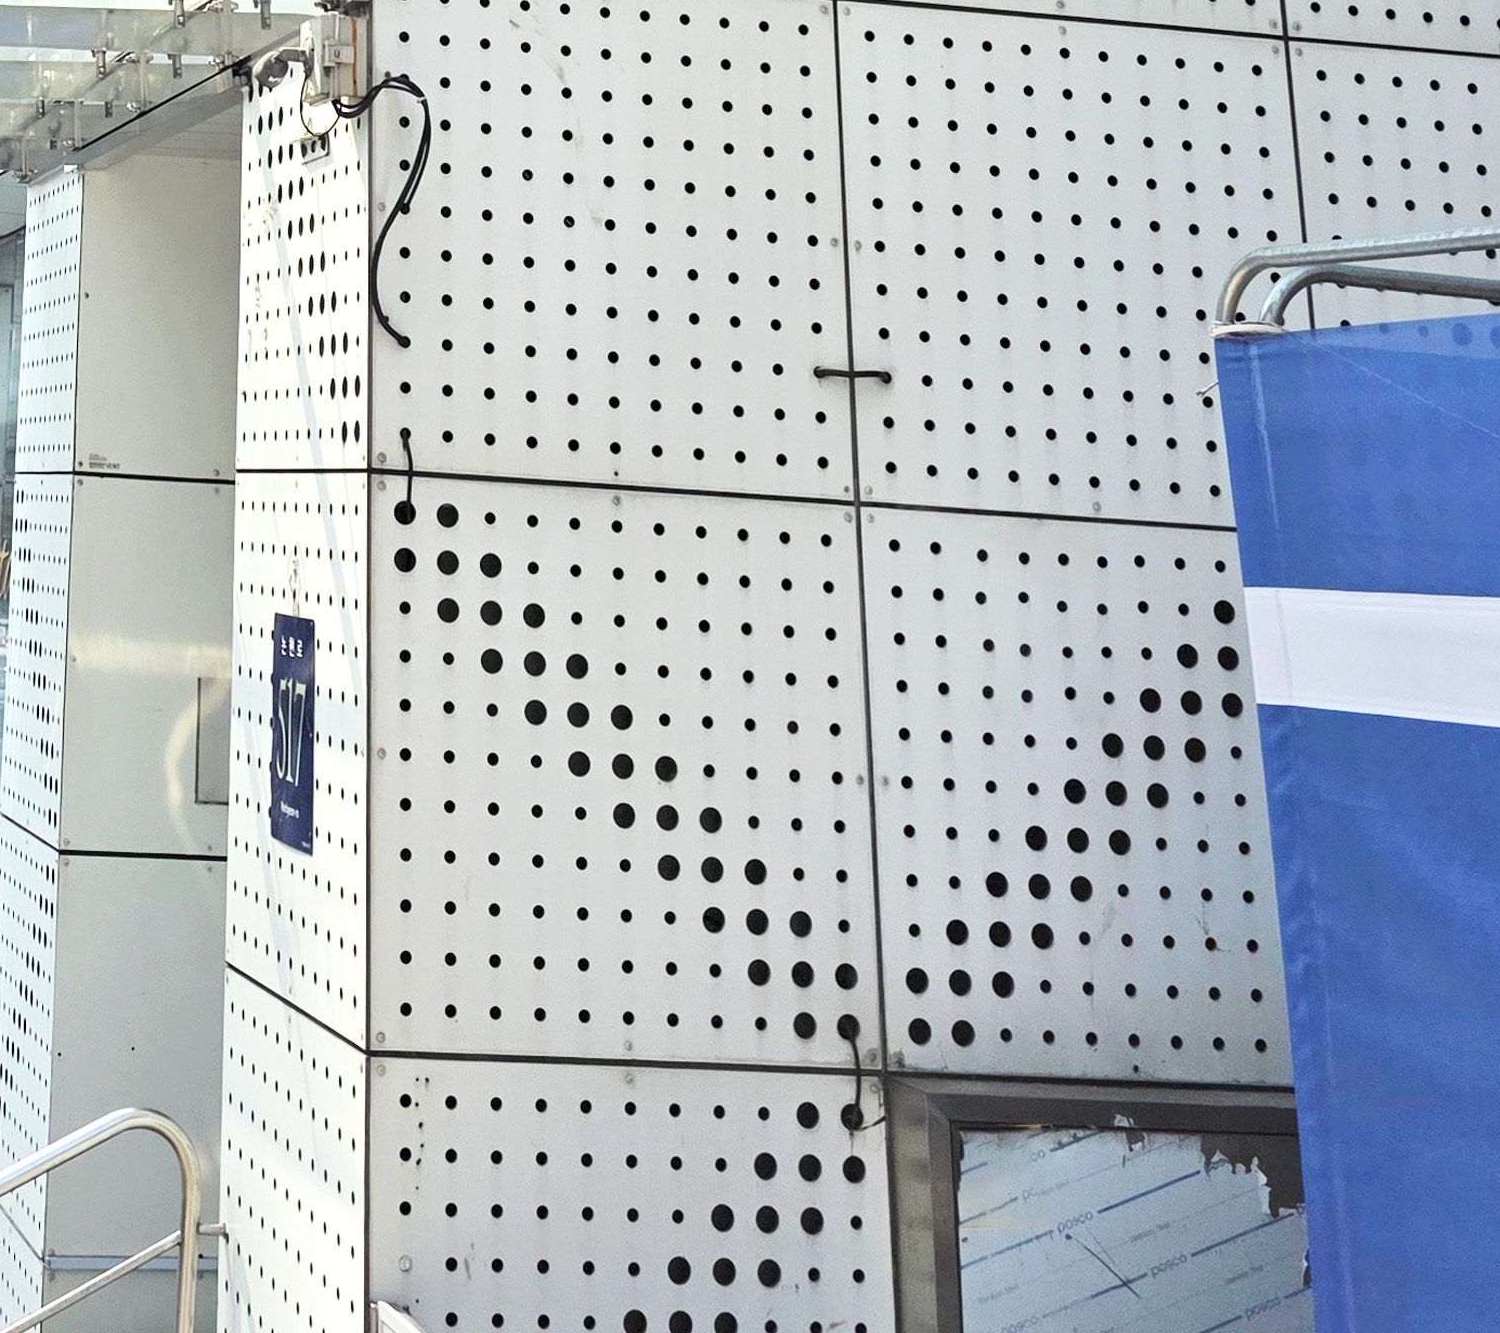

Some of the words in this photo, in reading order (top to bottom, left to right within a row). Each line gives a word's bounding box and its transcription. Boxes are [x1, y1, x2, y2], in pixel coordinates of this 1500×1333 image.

[276, 678, 306, 787] 517
[1057, 1211, 1093, 1235] posco
[1151, 1254, 1187, 1279] posco
[1245, 1297, 1281, 1320] posco
